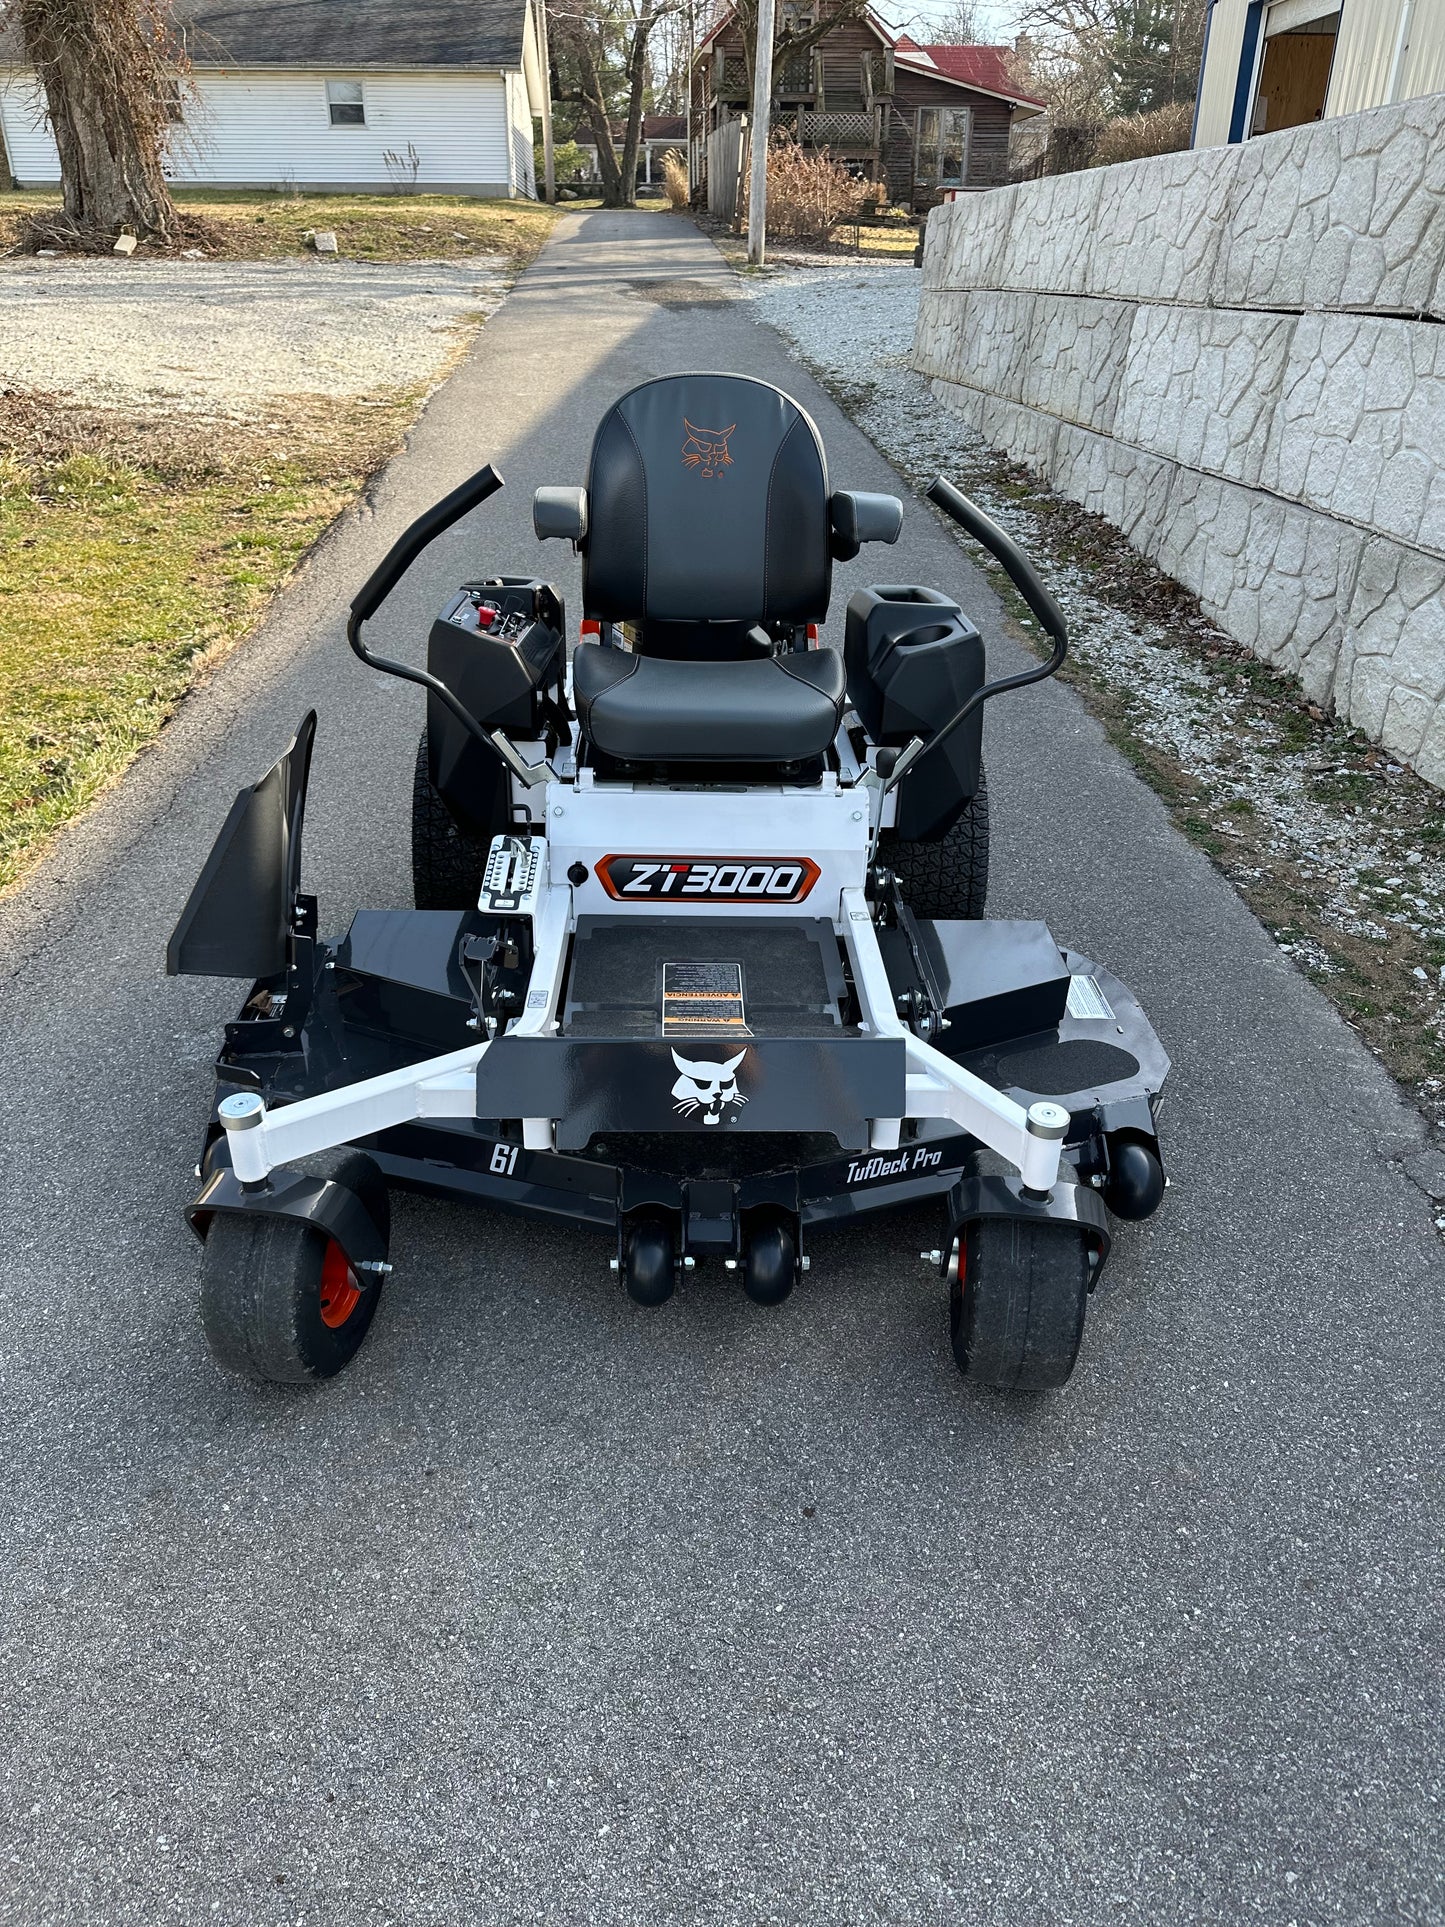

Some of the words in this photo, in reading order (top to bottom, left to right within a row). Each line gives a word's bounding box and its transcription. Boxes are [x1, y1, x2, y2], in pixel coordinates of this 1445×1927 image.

[622, 864, 803, 894] ZT3000
[489, 1143, 519, 1175] 61
[846, 1152, 910, 1184] TufDeck
[912, 1148, 943, 1170] Pro
